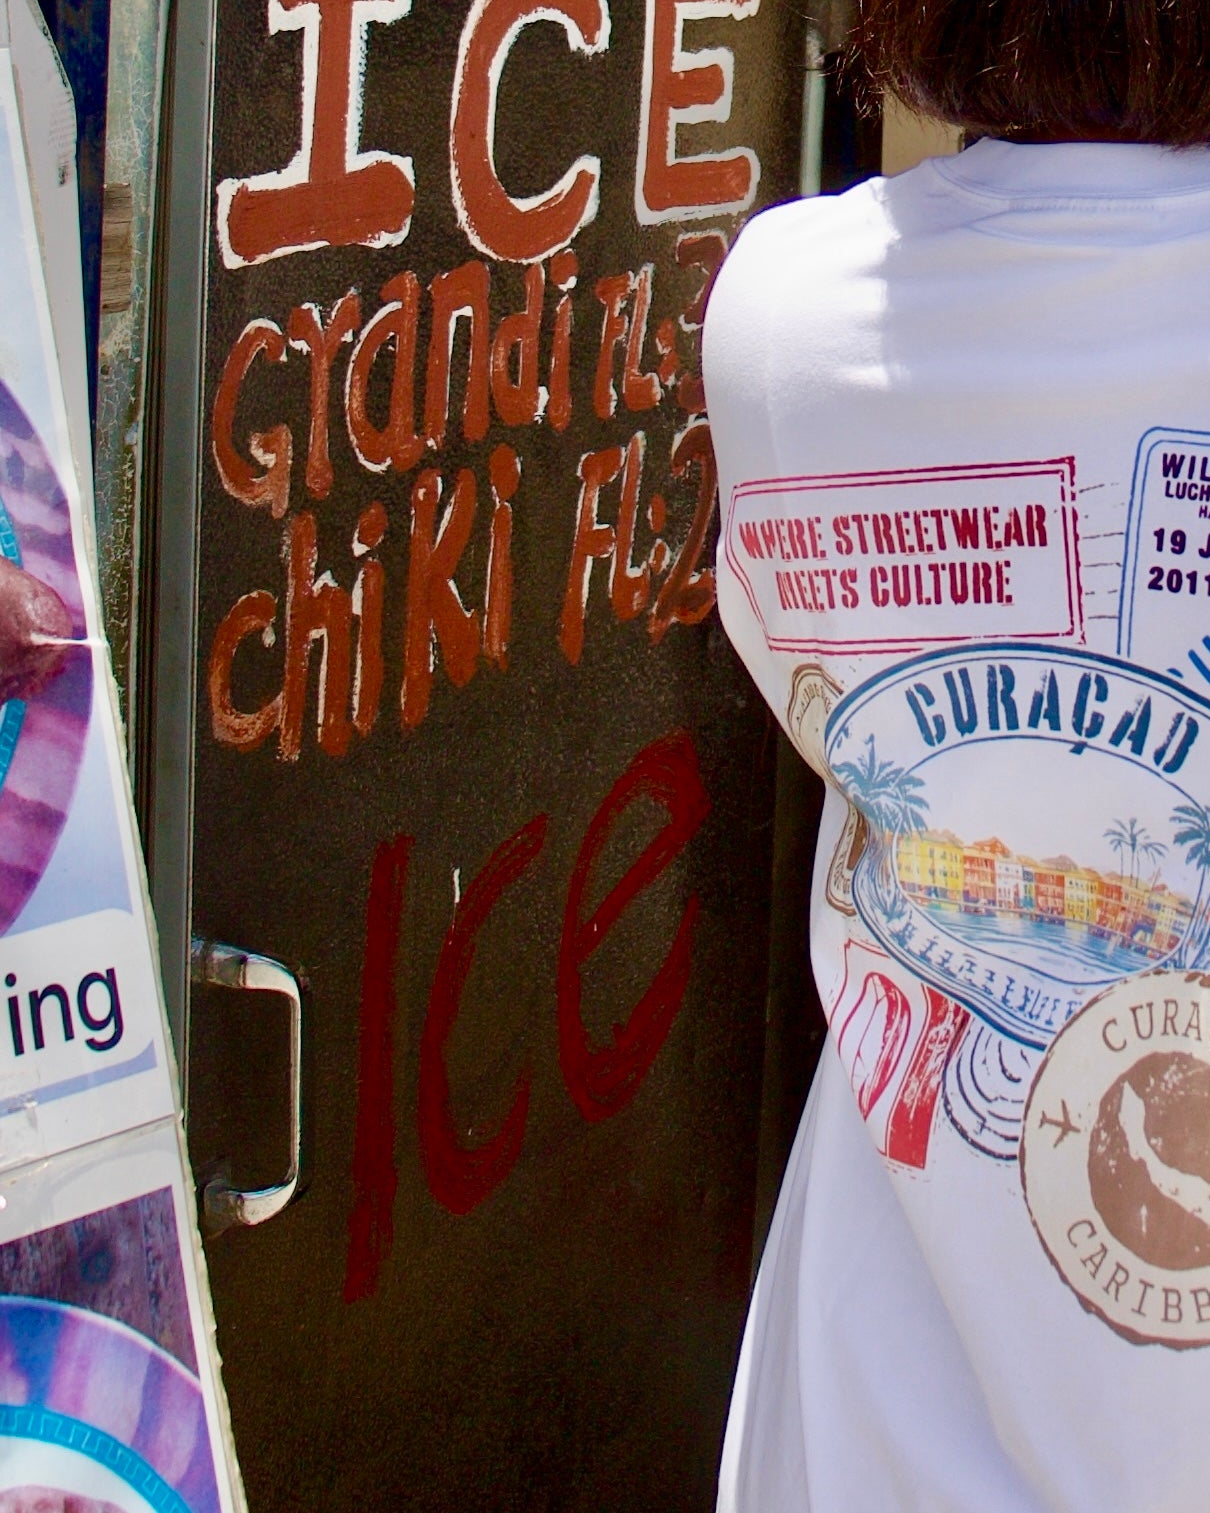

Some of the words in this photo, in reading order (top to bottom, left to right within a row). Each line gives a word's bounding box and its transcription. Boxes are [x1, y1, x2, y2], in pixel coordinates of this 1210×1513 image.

[211, 249, 579, 517] Grandi
[739, 514, 827, 563] WHERE
[833, 503, 1049, 558] STREETWEAR
[1152, 527, 1185, 556] 19
[776, 567, 861, 613] MEETS
[869, 559, 1014, 609] CULTURE
[5, 966, 125, 1057] ing
